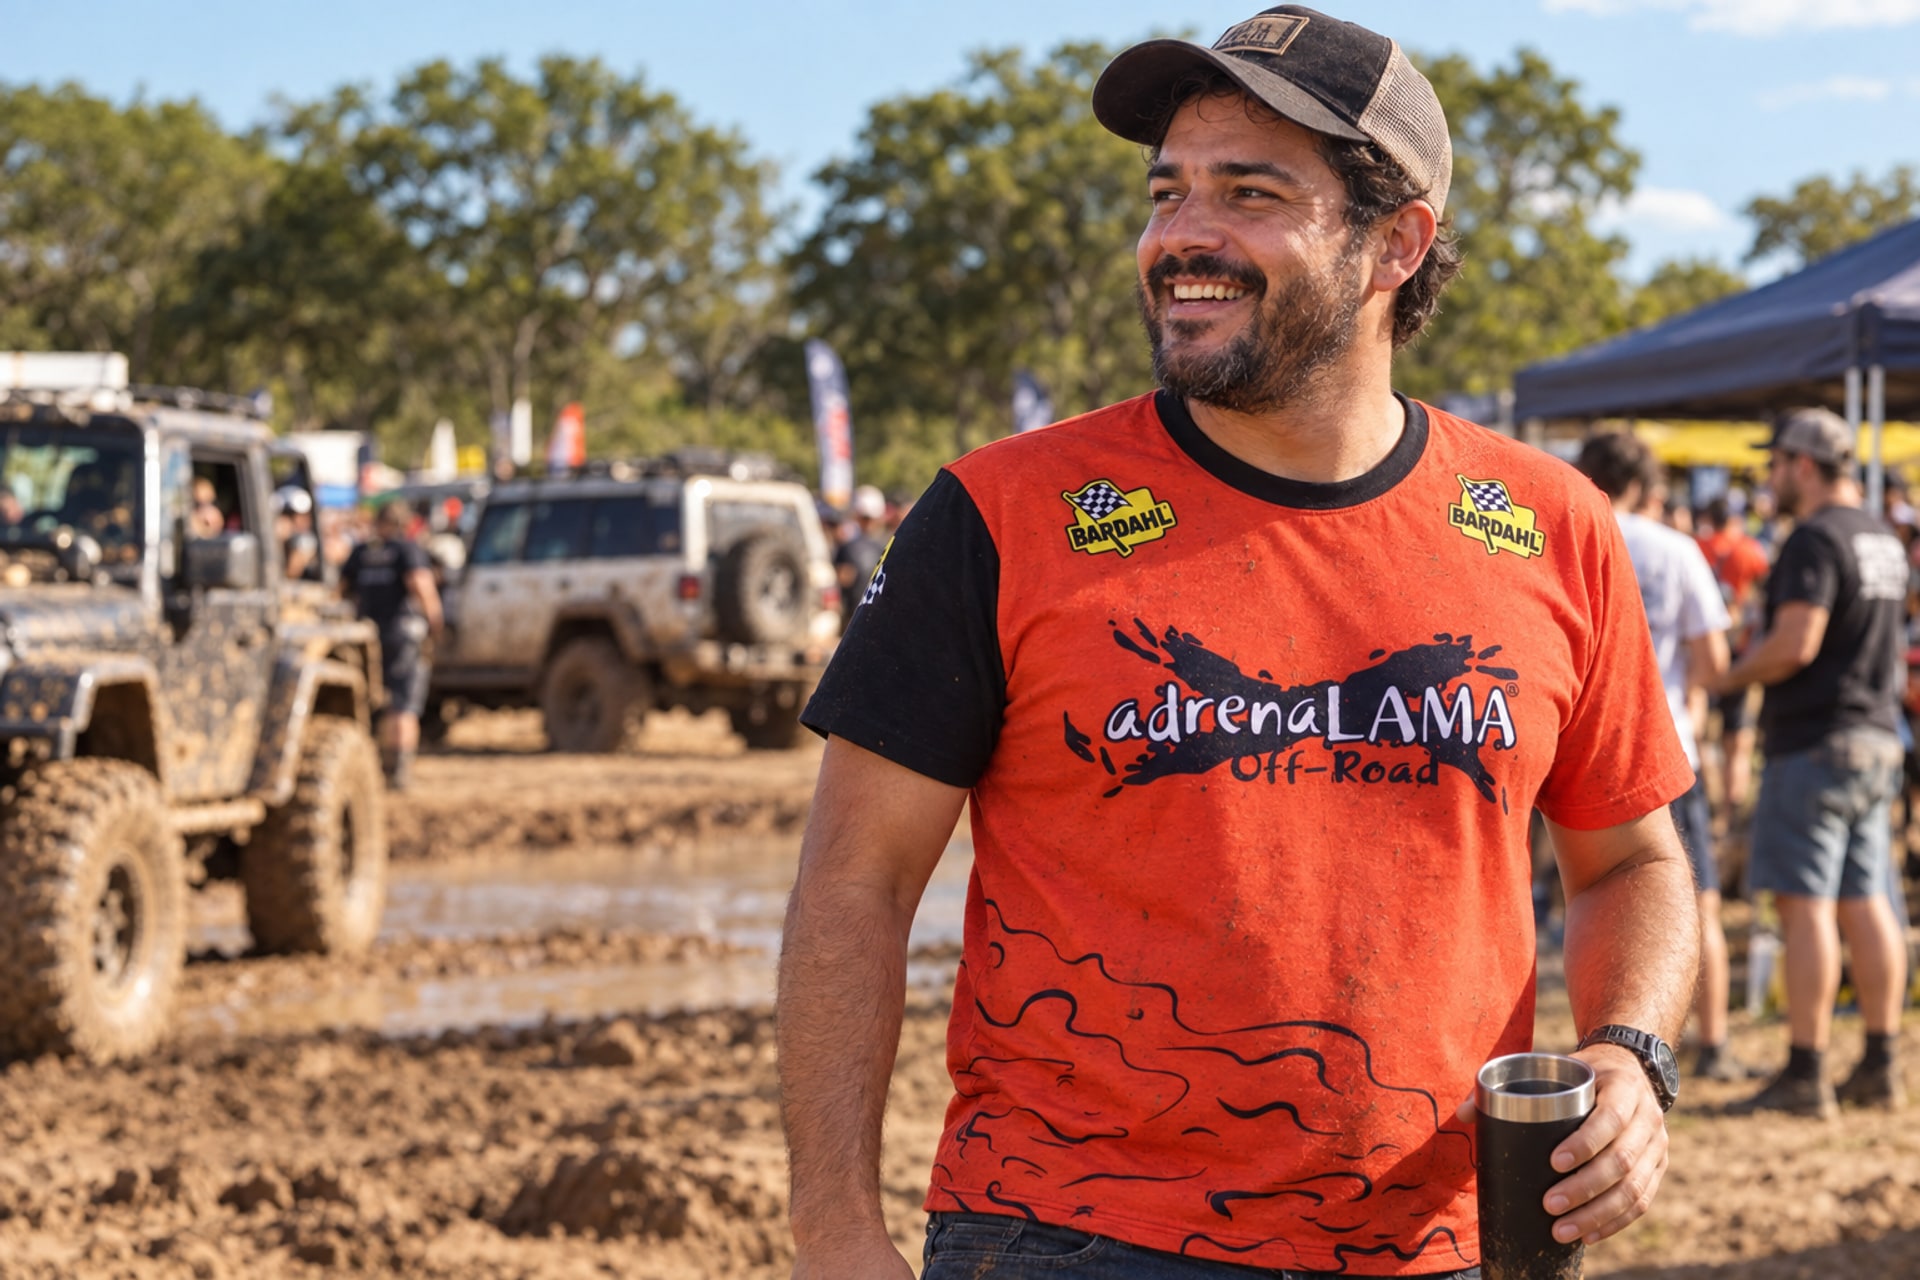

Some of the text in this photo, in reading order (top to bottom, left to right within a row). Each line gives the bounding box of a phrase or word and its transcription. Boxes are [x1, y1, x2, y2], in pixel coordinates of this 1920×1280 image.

[1070, 506, 1174, 553] BARDAHL
[1452, 507, 1540, 552] BARDAHL
[1231, 750, 1439, 786] Off-Road
